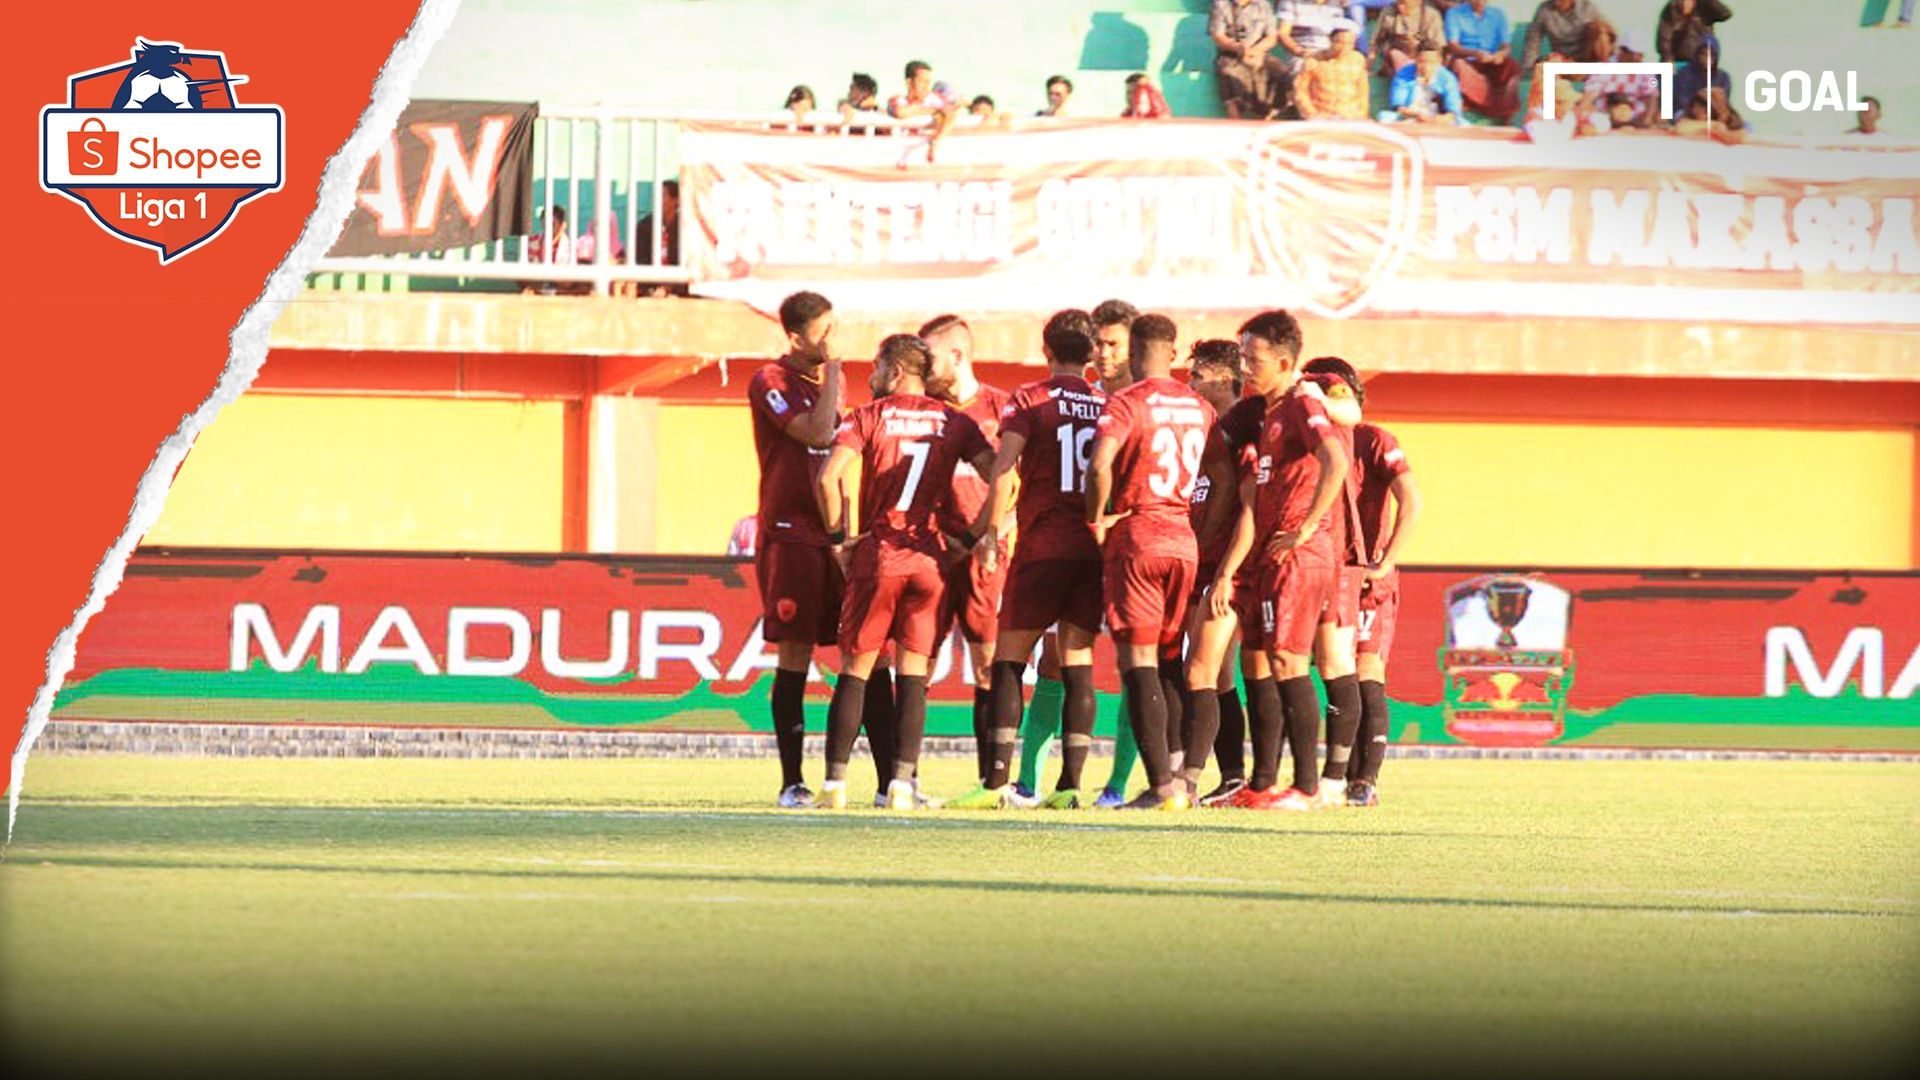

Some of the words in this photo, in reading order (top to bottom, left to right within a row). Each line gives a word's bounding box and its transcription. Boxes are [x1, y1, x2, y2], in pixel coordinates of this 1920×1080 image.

[1434, 185, 1572, 264] PSM
[895, 441, 931, 512] 7
[1148, 426, 1206, 498] 39
[229, 602, 825, 682] MADURA
